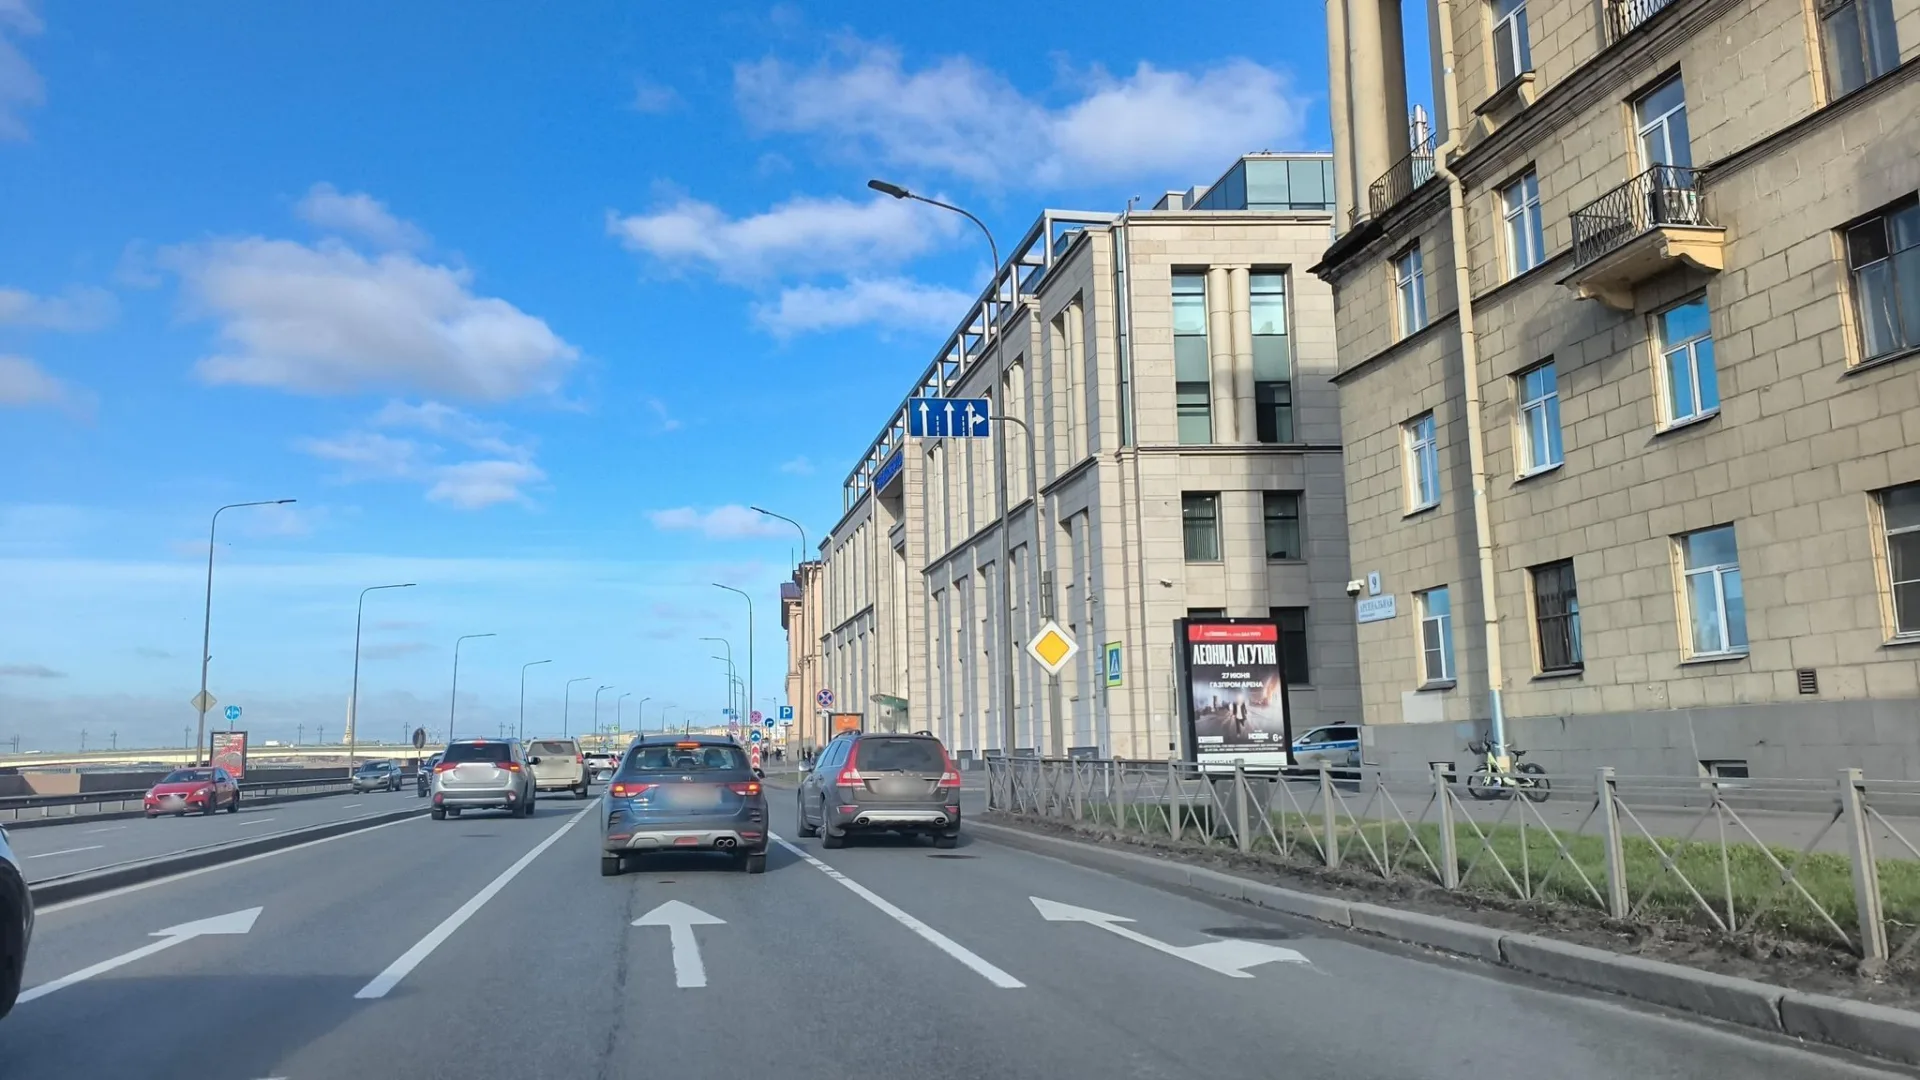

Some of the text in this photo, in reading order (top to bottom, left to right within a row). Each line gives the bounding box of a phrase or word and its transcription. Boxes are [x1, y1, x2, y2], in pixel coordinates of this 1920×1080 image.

[1371, 576, 1377, 588] 9
[1193, 644, 1276, 667] ЛЕОНИД АГУТИН
[783, 706, 791, 718] P
[1272, 733, 1283, 742] 6+
